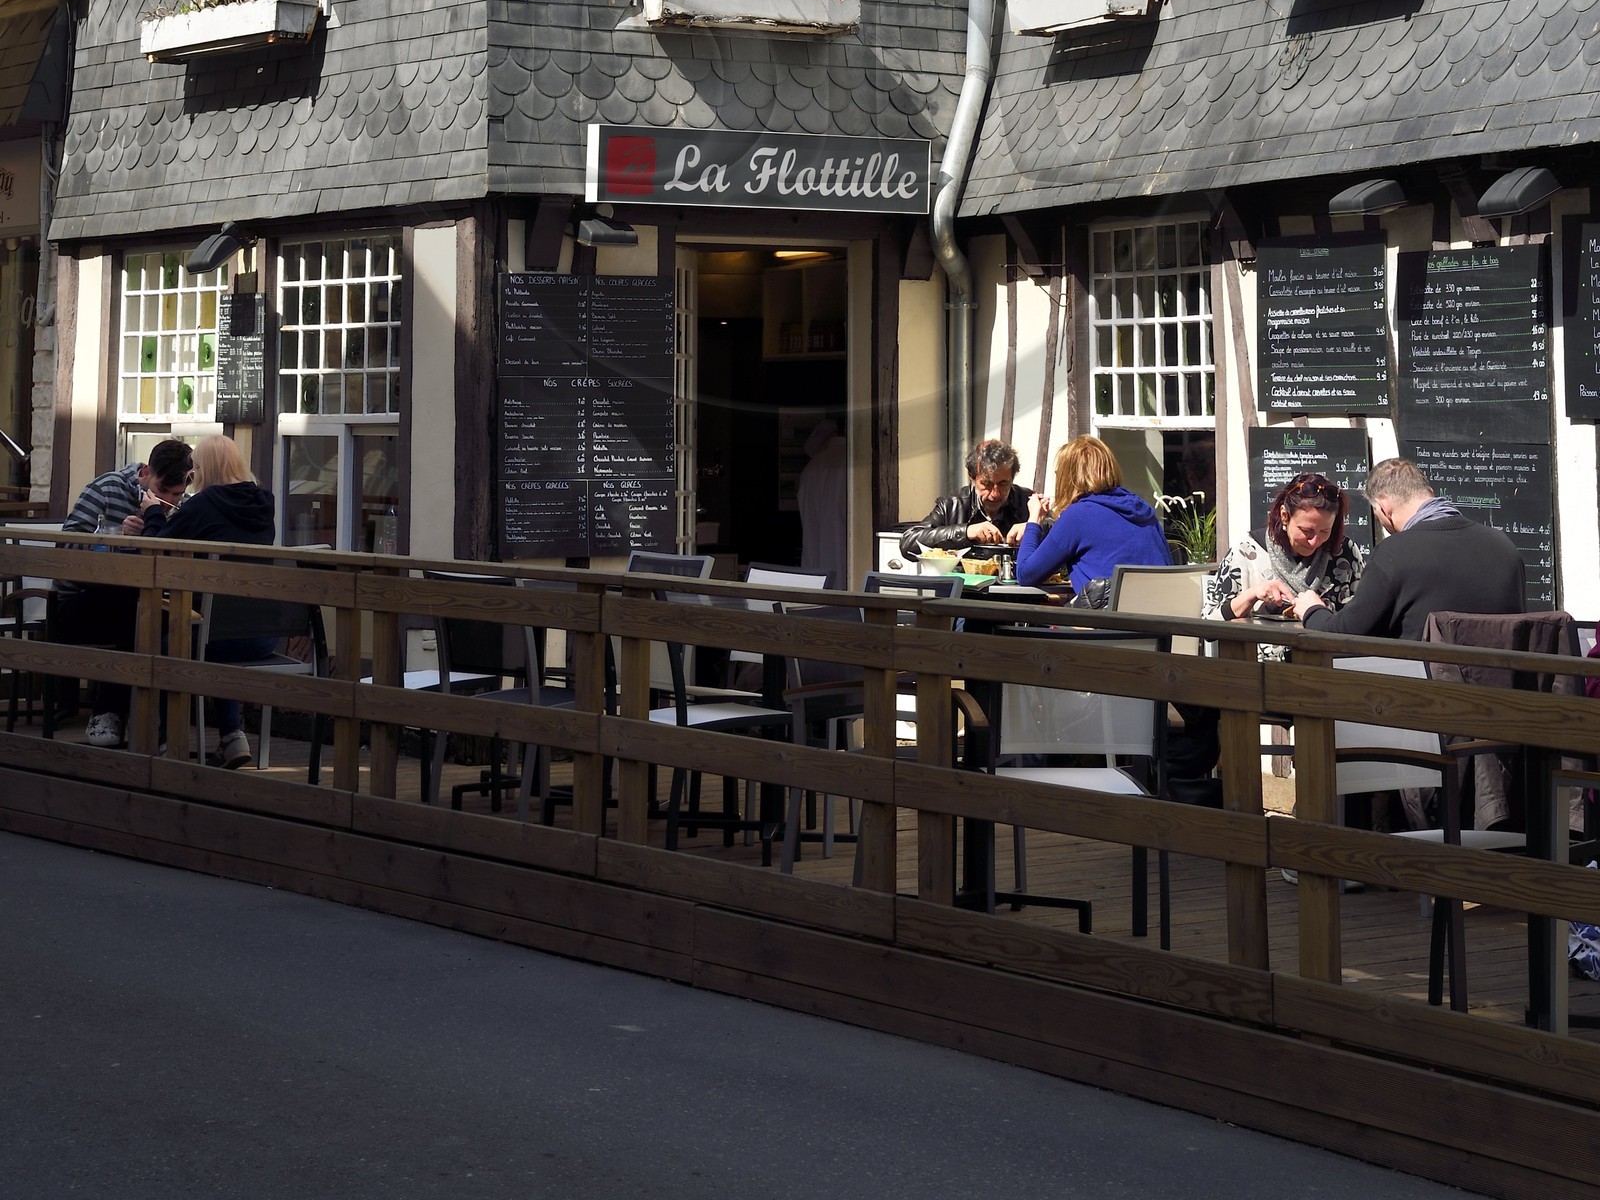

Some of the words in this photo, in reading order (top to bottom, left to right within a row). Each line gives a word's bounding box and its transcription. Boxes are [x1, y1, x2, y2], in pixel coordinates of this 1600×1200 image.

[664, 144, 730, 192] La
[744, 147, 918, 199] Flottille
[510, 275, 524, 284] NOS
[528, 276, 556, 285] DESSERTS
[1268, 269, 1287, 282] Moules
[543, 378, 557, 387] NOS
[1416, 447, 1431, 458] Toutes
[1442, 449, 1459, 458] viandes
